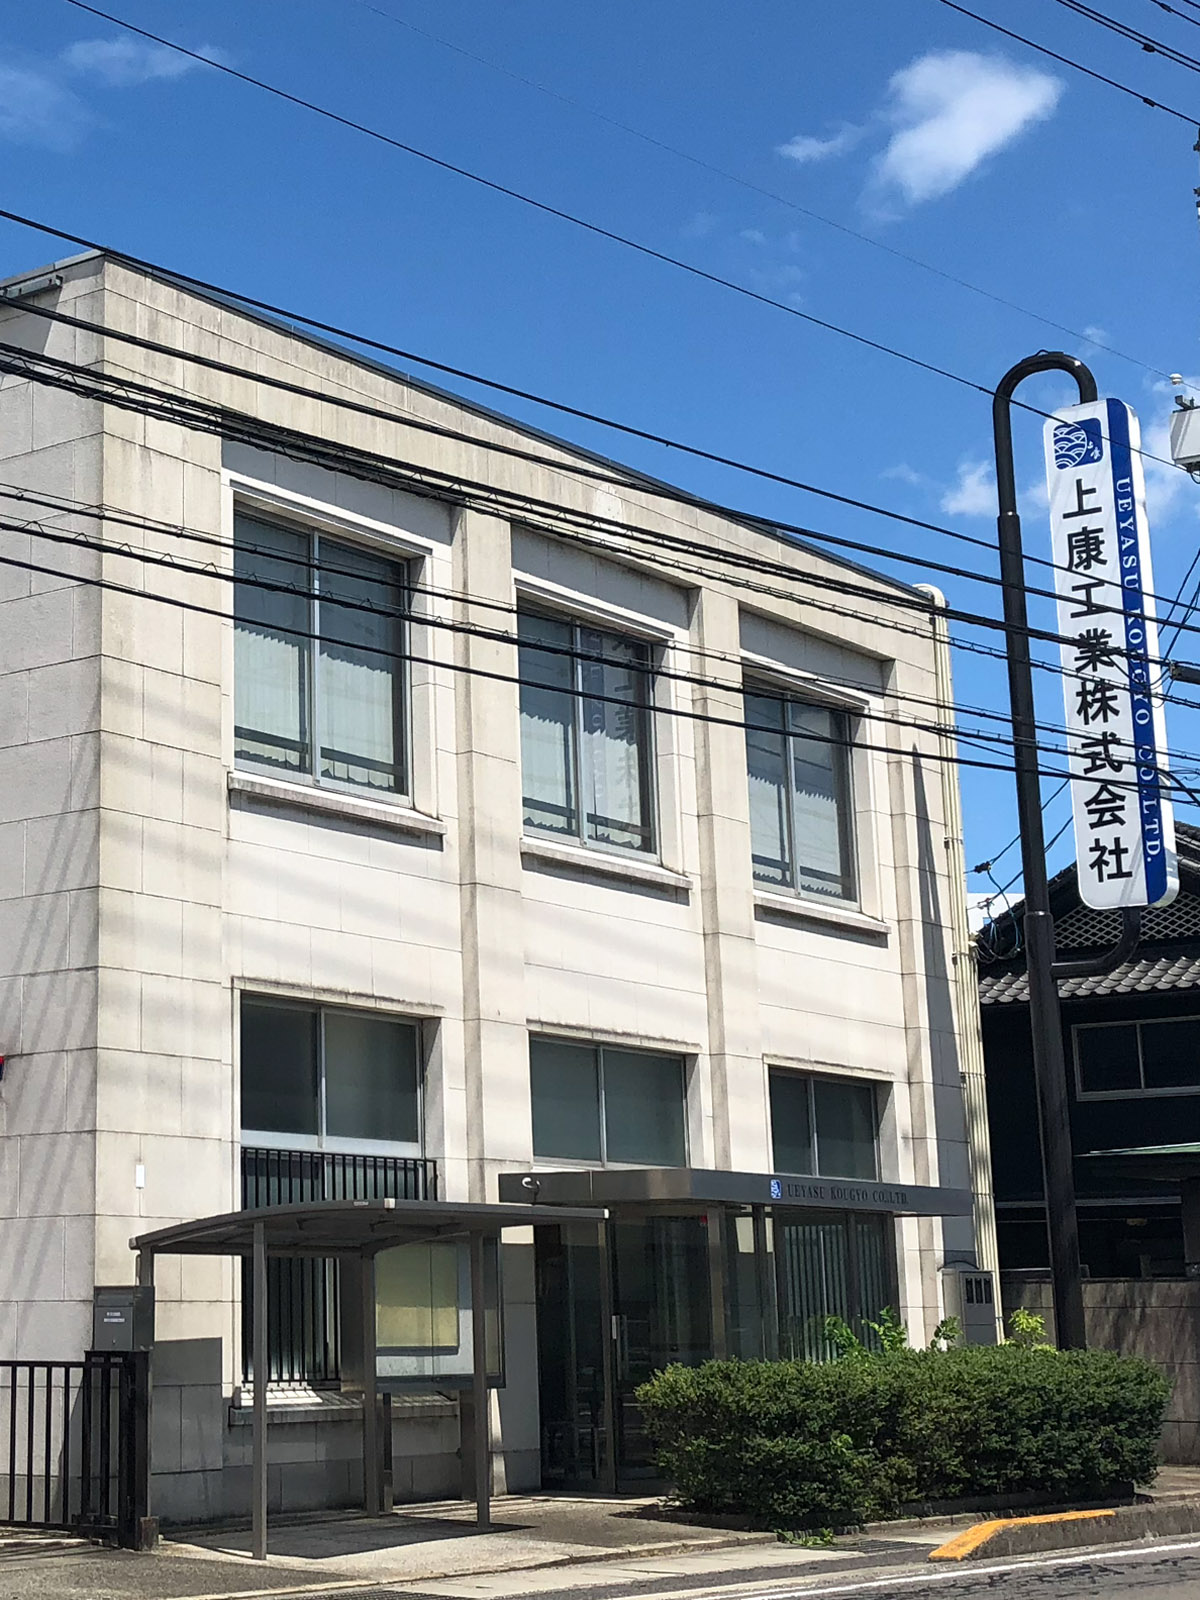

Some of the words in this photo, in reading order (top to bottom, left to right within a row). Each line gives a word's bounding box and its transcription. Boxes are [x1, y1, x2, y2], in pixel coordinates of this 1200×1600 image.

[1116, 477, 1139, 591] UEYASU
[1062, 478, 1133, 883] 上康工業株式会社
[830, 1186, 868, 1202] KOUGYO
